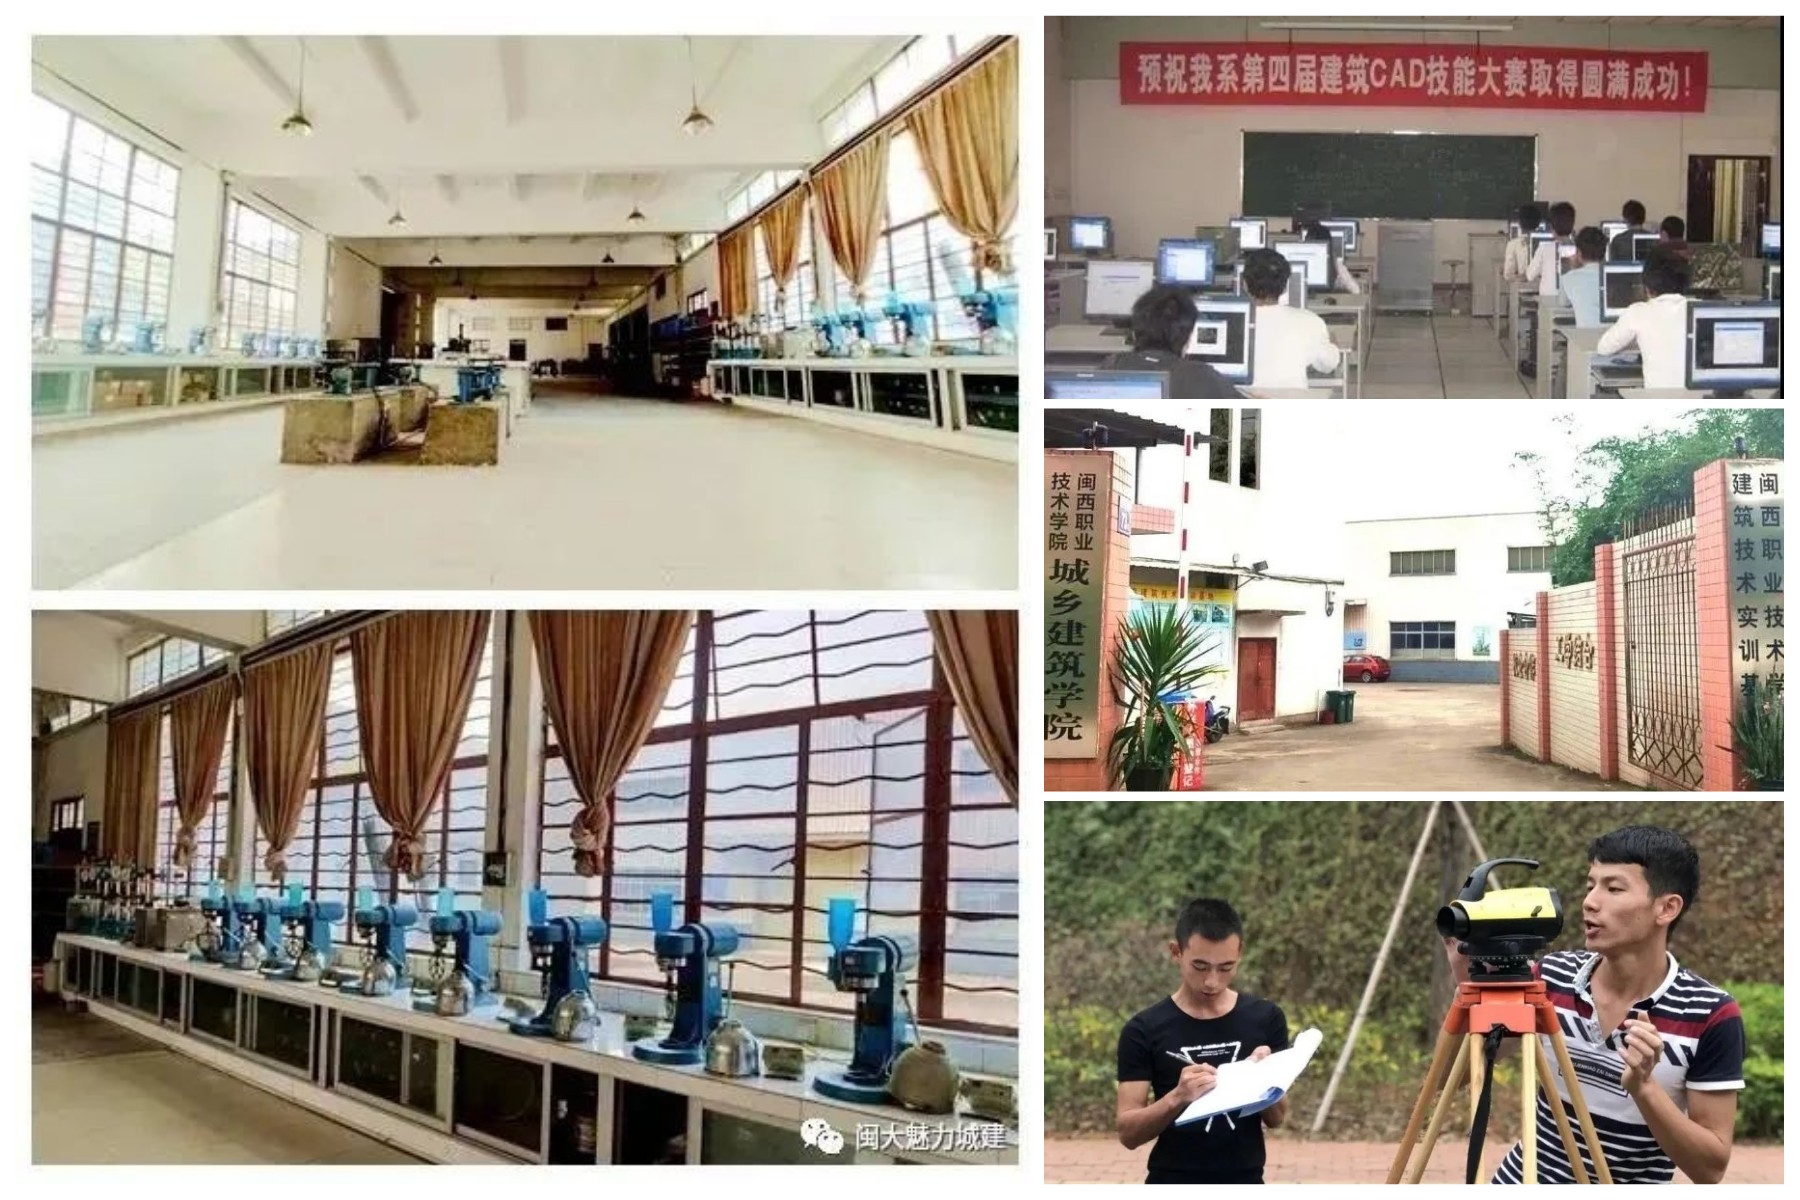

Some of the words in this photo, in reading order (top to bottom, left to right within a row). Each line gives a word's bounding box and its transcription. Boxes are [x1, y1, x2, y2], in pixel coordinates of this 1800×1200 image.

[1048, 472, 1071, 551] 技术学院
[1074, 473, 1096, 551] 闽西职业
[1044, 558, 1090, 741] 城乡建筑学院
